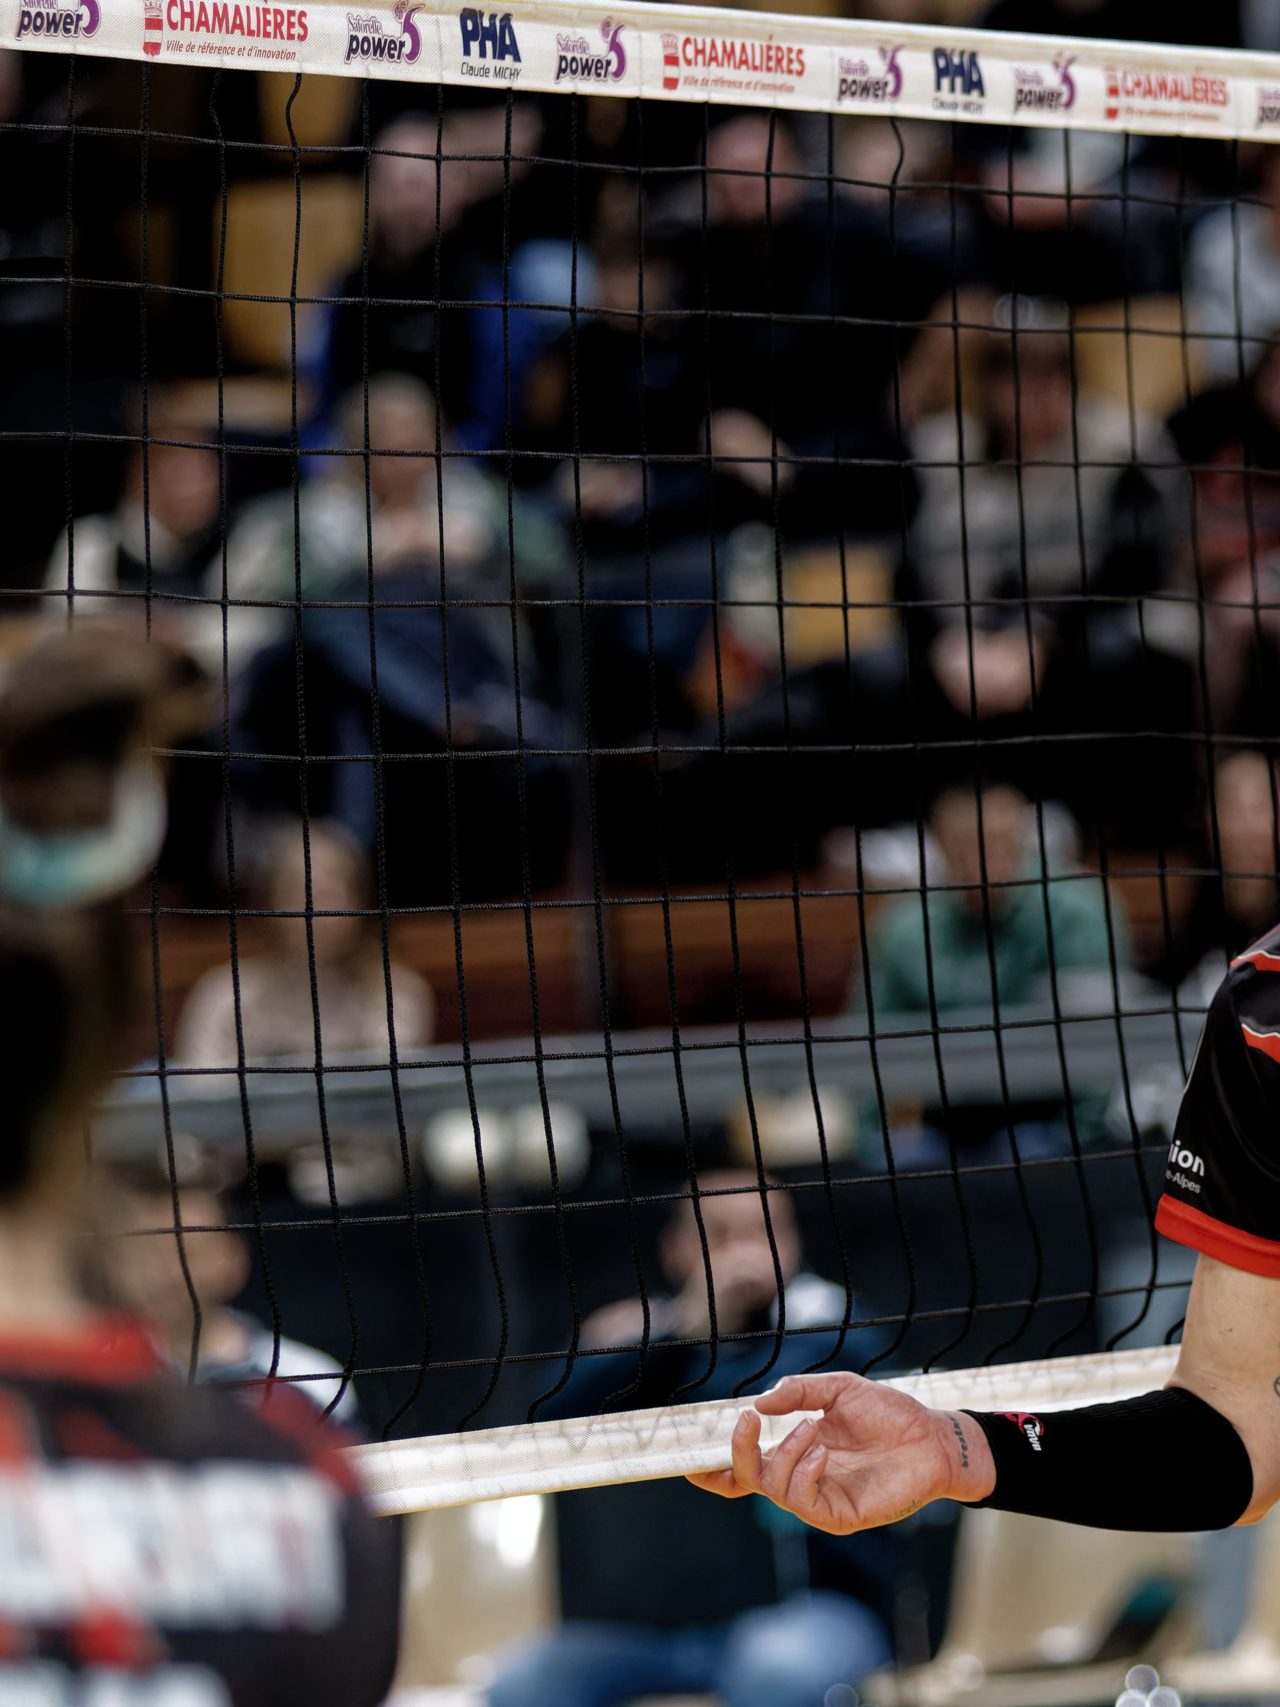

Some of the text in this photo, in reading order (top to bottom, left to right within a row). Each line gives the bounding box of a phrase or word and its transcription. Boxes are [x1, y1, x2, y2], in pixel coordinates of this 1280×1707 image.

[166, 0, 308, 42] CHAMALIÈRES
[459, 7, 522, 63] PHA
[166, 39, 296, 61] Ville de référence et d'innovation
[461, 61, 522, 81] Claude MICHY
[933, 47, 985, 97] PHA
